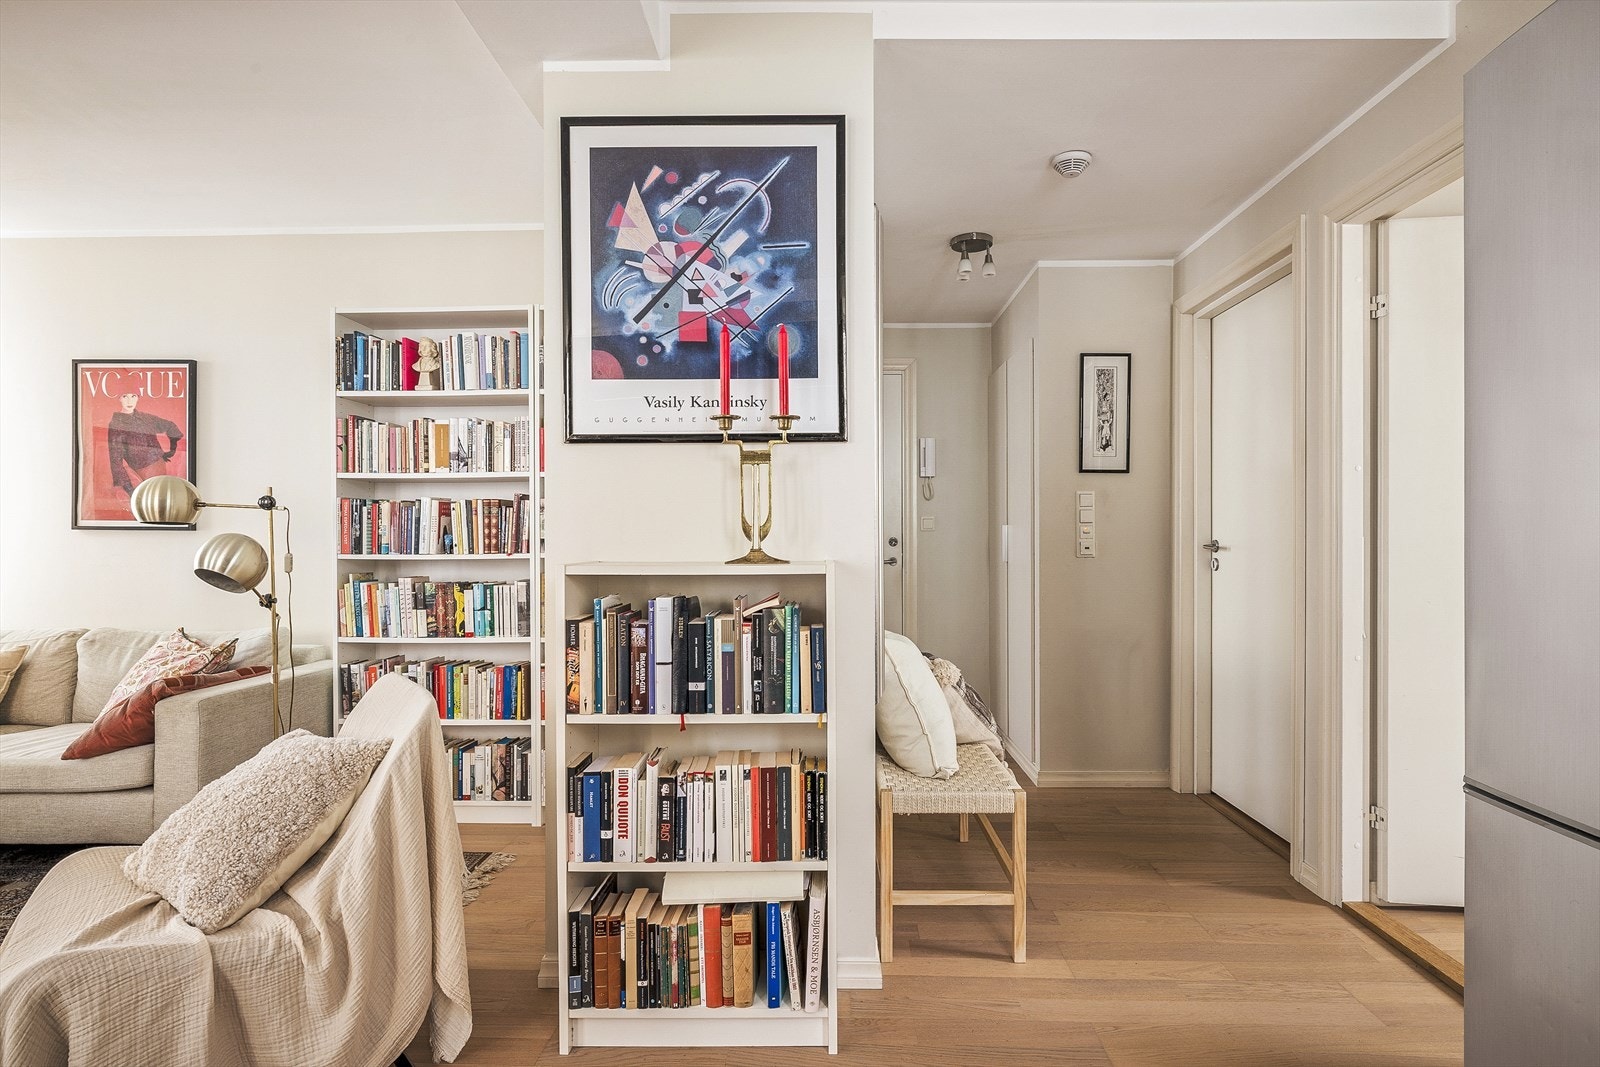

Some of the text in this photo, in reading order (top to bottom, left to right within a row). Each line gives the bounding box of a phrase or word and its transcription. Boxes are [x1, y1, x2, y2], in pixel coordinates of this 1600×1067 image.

[644, 395, 767, 412] Vasily Kaninsky
[618, 777, 629, 798] DON
[617, 800, 629, 839] QUIJOTE
[660, 823, 670, 842] FAUST
[811, 908, 821, 964] ASBJØRNSEN
[810, 975, 818, 995] MOE
